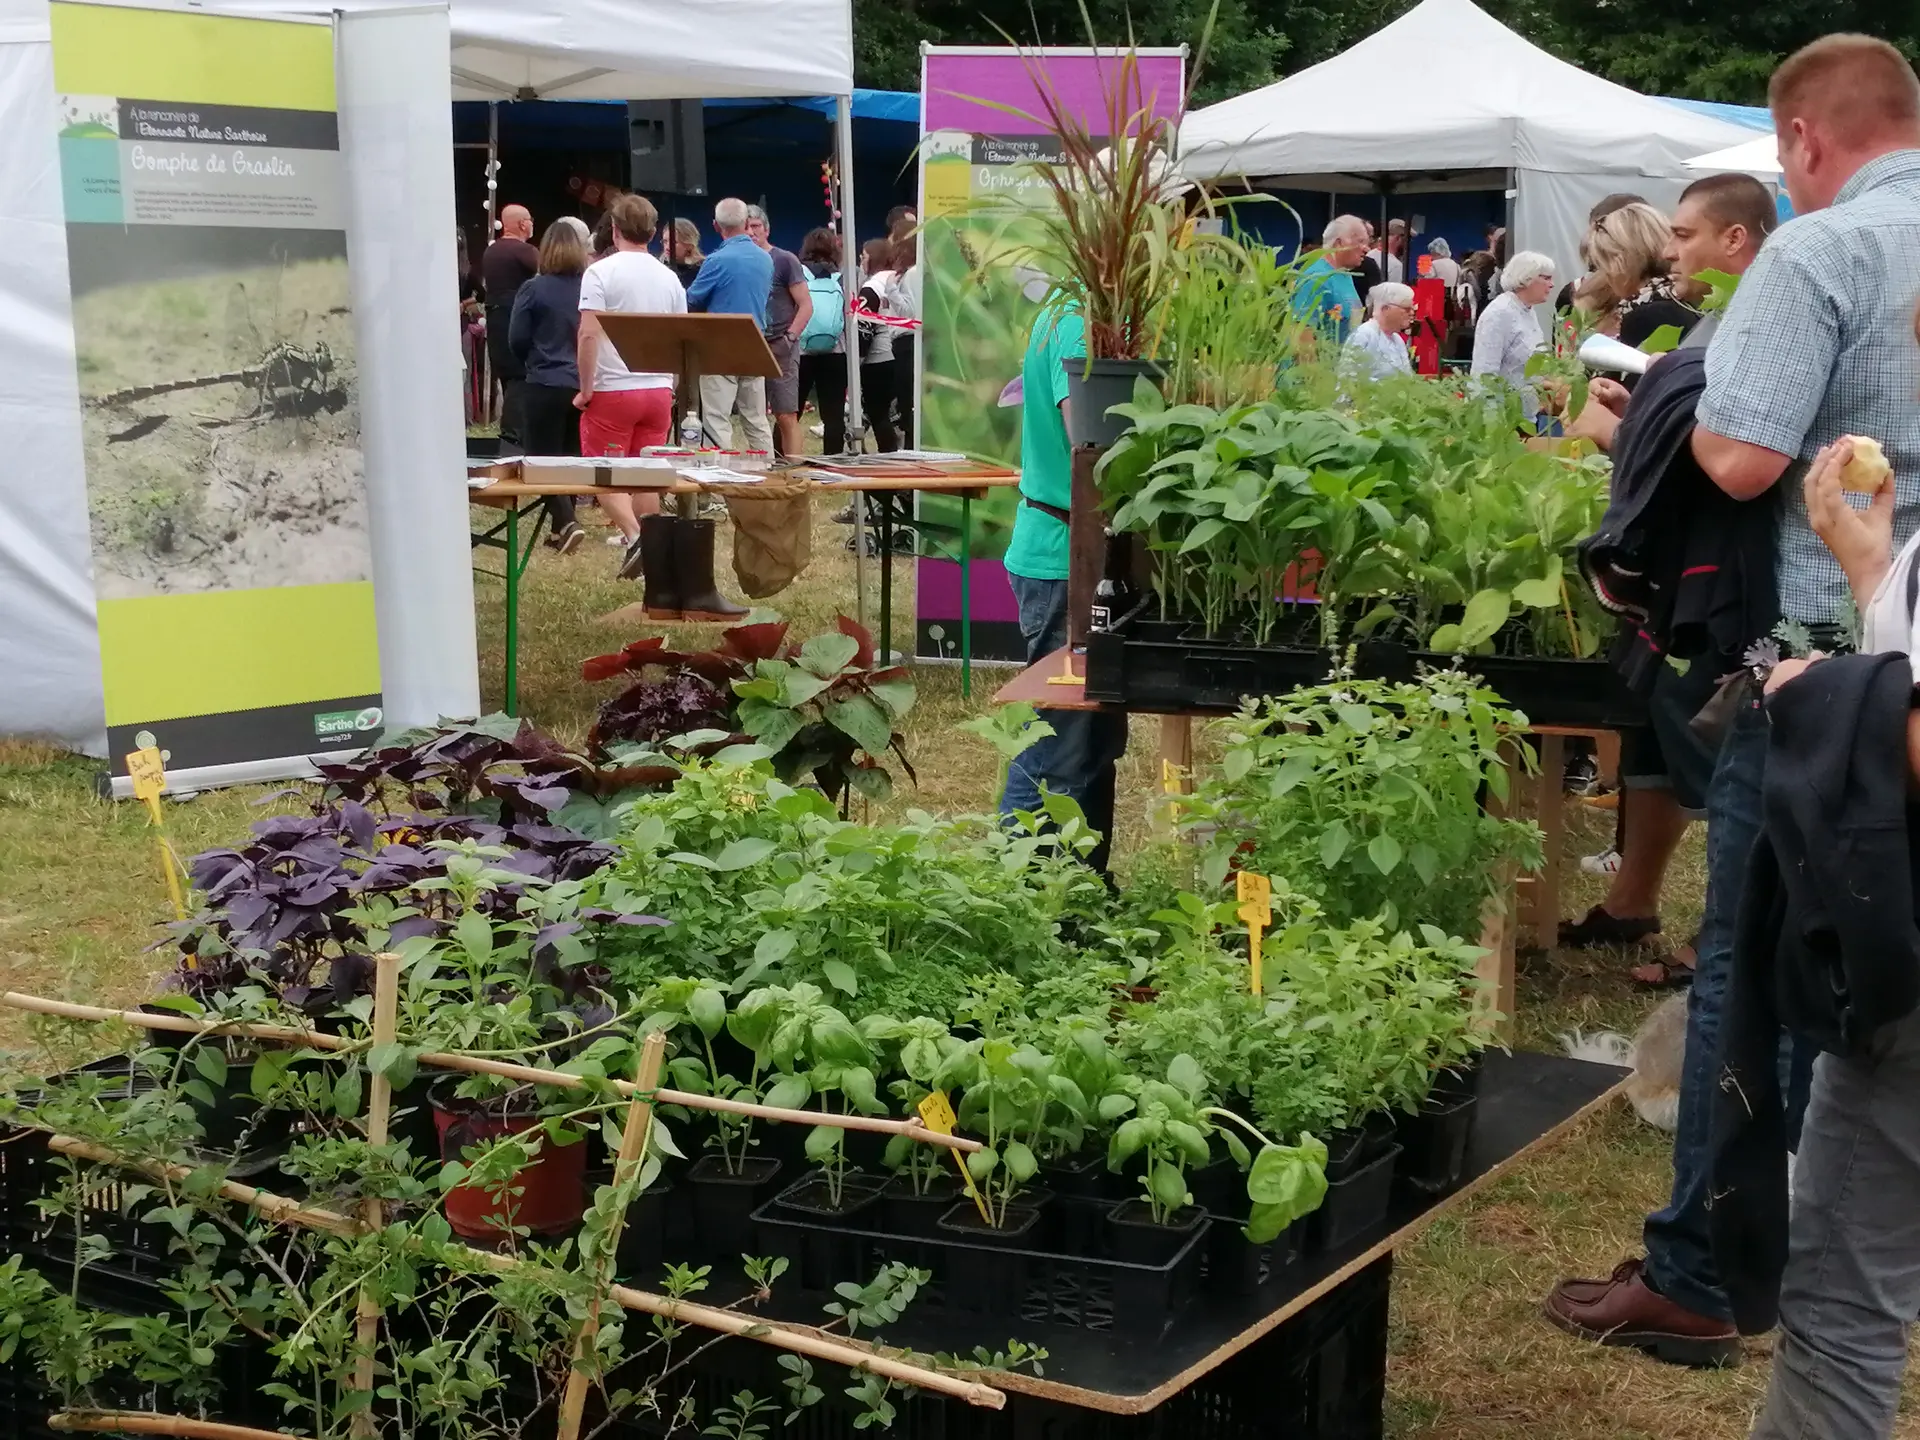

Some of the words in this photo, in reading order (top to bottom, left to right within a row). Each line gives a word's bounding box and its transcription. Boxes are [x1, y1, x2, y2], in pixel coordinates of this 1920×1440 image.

[188, 124, 223, 141] Nature
[224, 126, 268, 143] Sarthoise
[131, 145, 200, 177] Gomphe
[206, 152, 227, 175] de
[232, 150, 296, 178] Graslin
[318, 719, 354, 732] Sarthe
